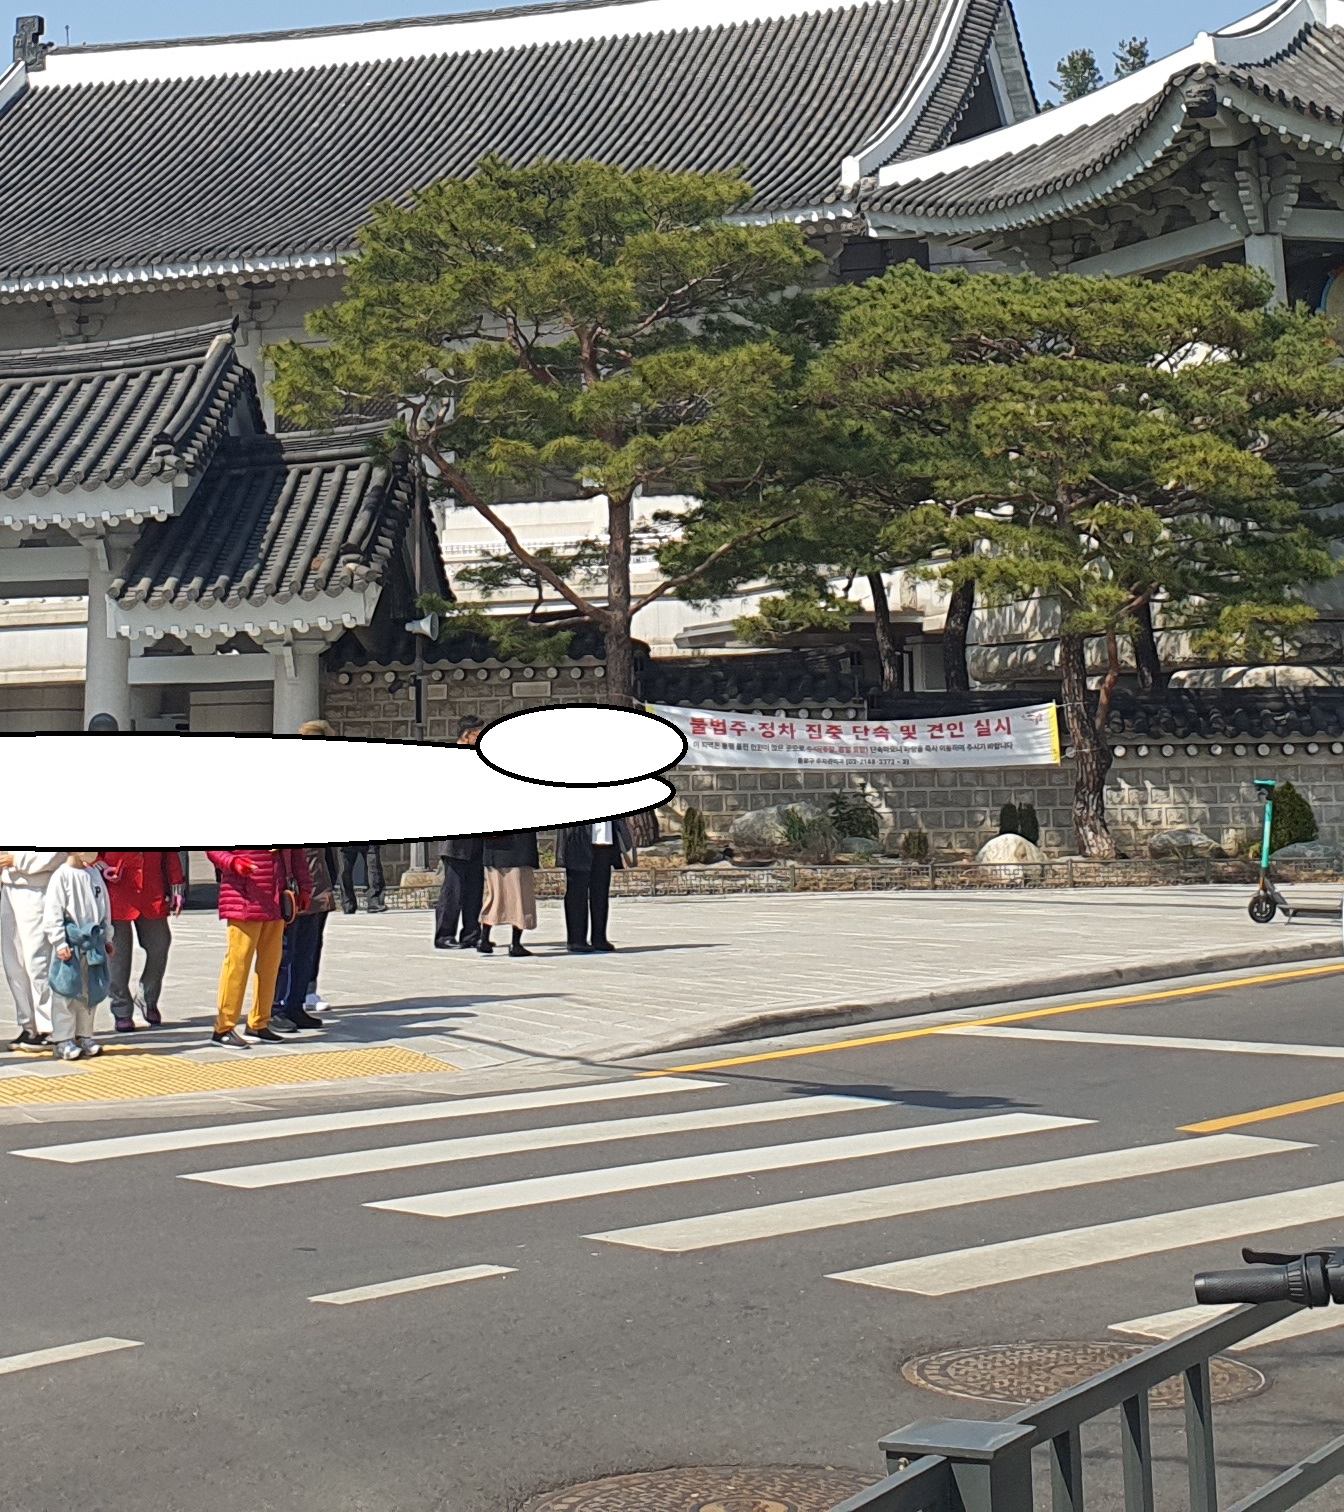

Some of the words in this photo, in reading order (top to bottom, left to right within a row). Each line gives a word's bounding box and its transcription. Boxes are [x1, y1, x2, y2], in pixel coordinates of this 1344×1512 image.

[690, 717, 796, 740] 불법주·정차
[805, 724, 843, 740] 집중
[852, 725, 890, 741] 단속
[899, 724, 918, 740] 및
[927, 721, 965, 739] 견인
[974, 716, 1012, 737] 실시
